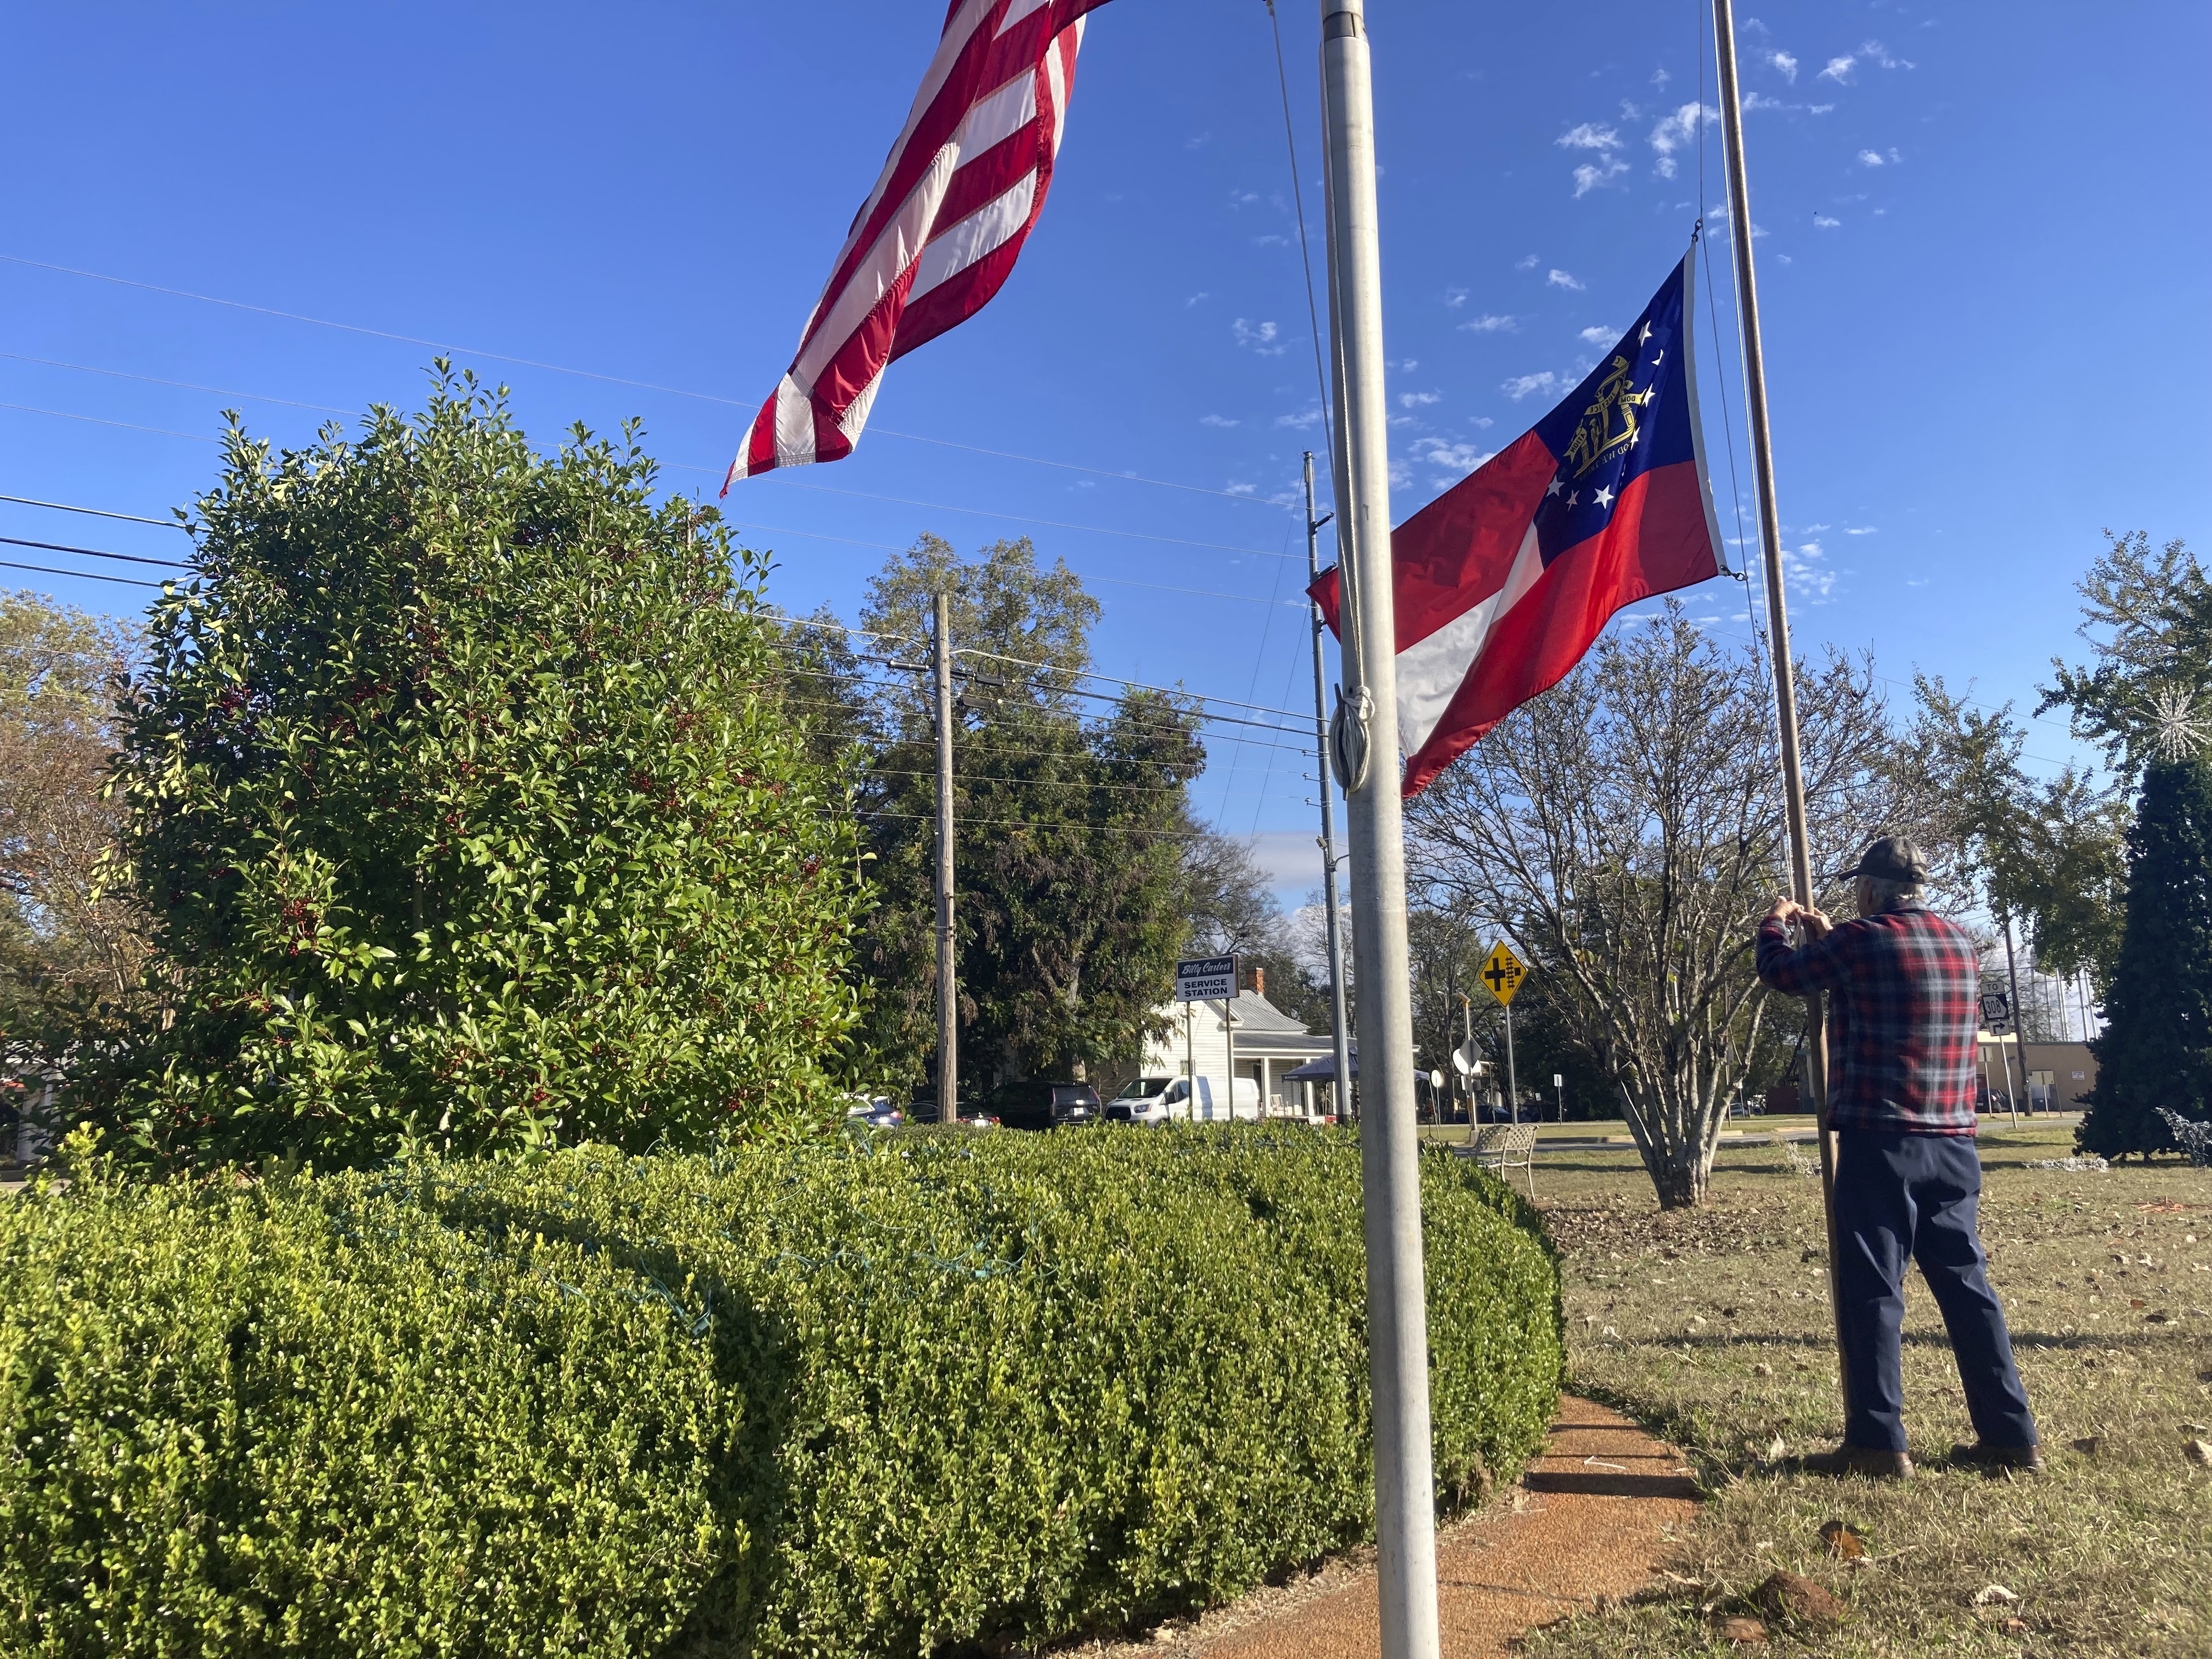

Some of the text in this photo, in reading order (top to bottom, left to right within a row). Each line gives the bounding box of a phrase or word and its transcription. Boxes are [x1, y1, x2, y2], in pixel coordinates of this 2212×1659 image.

[1181, 963, 1201, 976] Billy
[1184, 979, 1227, 989] SERVICE
[1184, 987, 1227, 997] STATION
[1986, 1000, 2001, 1014] 308
